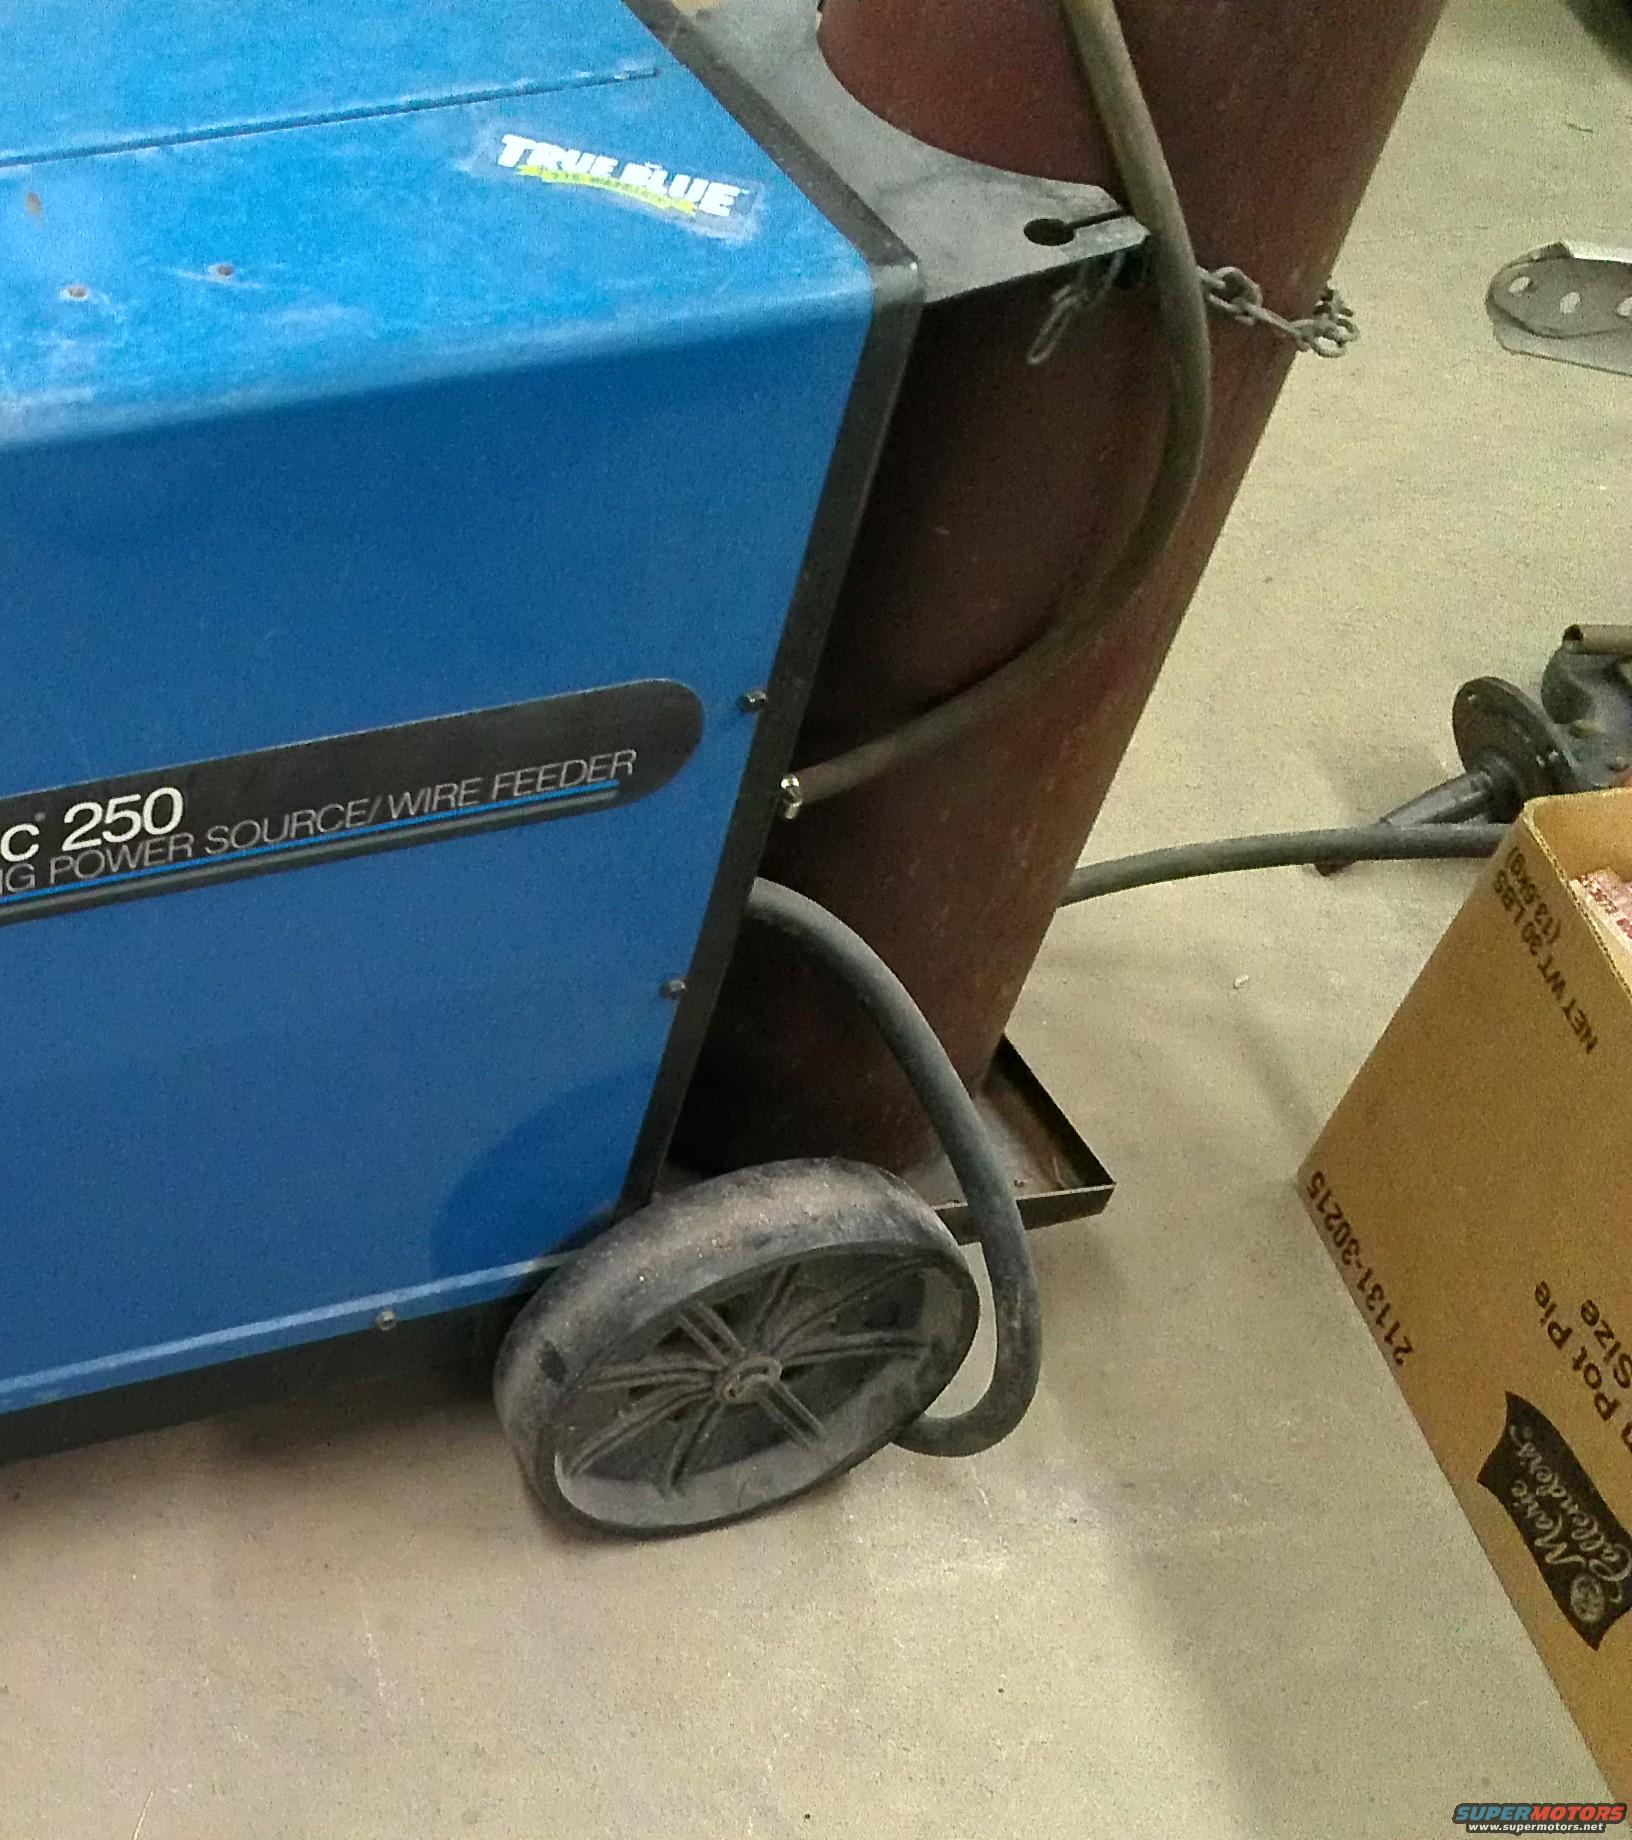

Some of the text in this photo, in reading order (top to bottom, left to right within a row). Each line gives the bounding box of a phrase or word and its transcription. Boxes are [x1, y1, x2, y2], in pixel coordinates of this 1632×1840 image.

[497, 134, 619, 177] TRUE
[618, 161, 742, 217] BLUE
[48, 832, 195, 885] POWER
[491, 748, 638, 802] FEEDER
[61, 787, 184, 852] 250
[1493, 869, 1598, 1055] NET WT 30 LBS
[1306, 1170, 1414, 1366] 21131-30215
[1534, 1279, 1621, 1422] Pot Pie
[1580, 1299, 1632, 1390] Size
[1511, 1480, 1586, 1567] Marie
